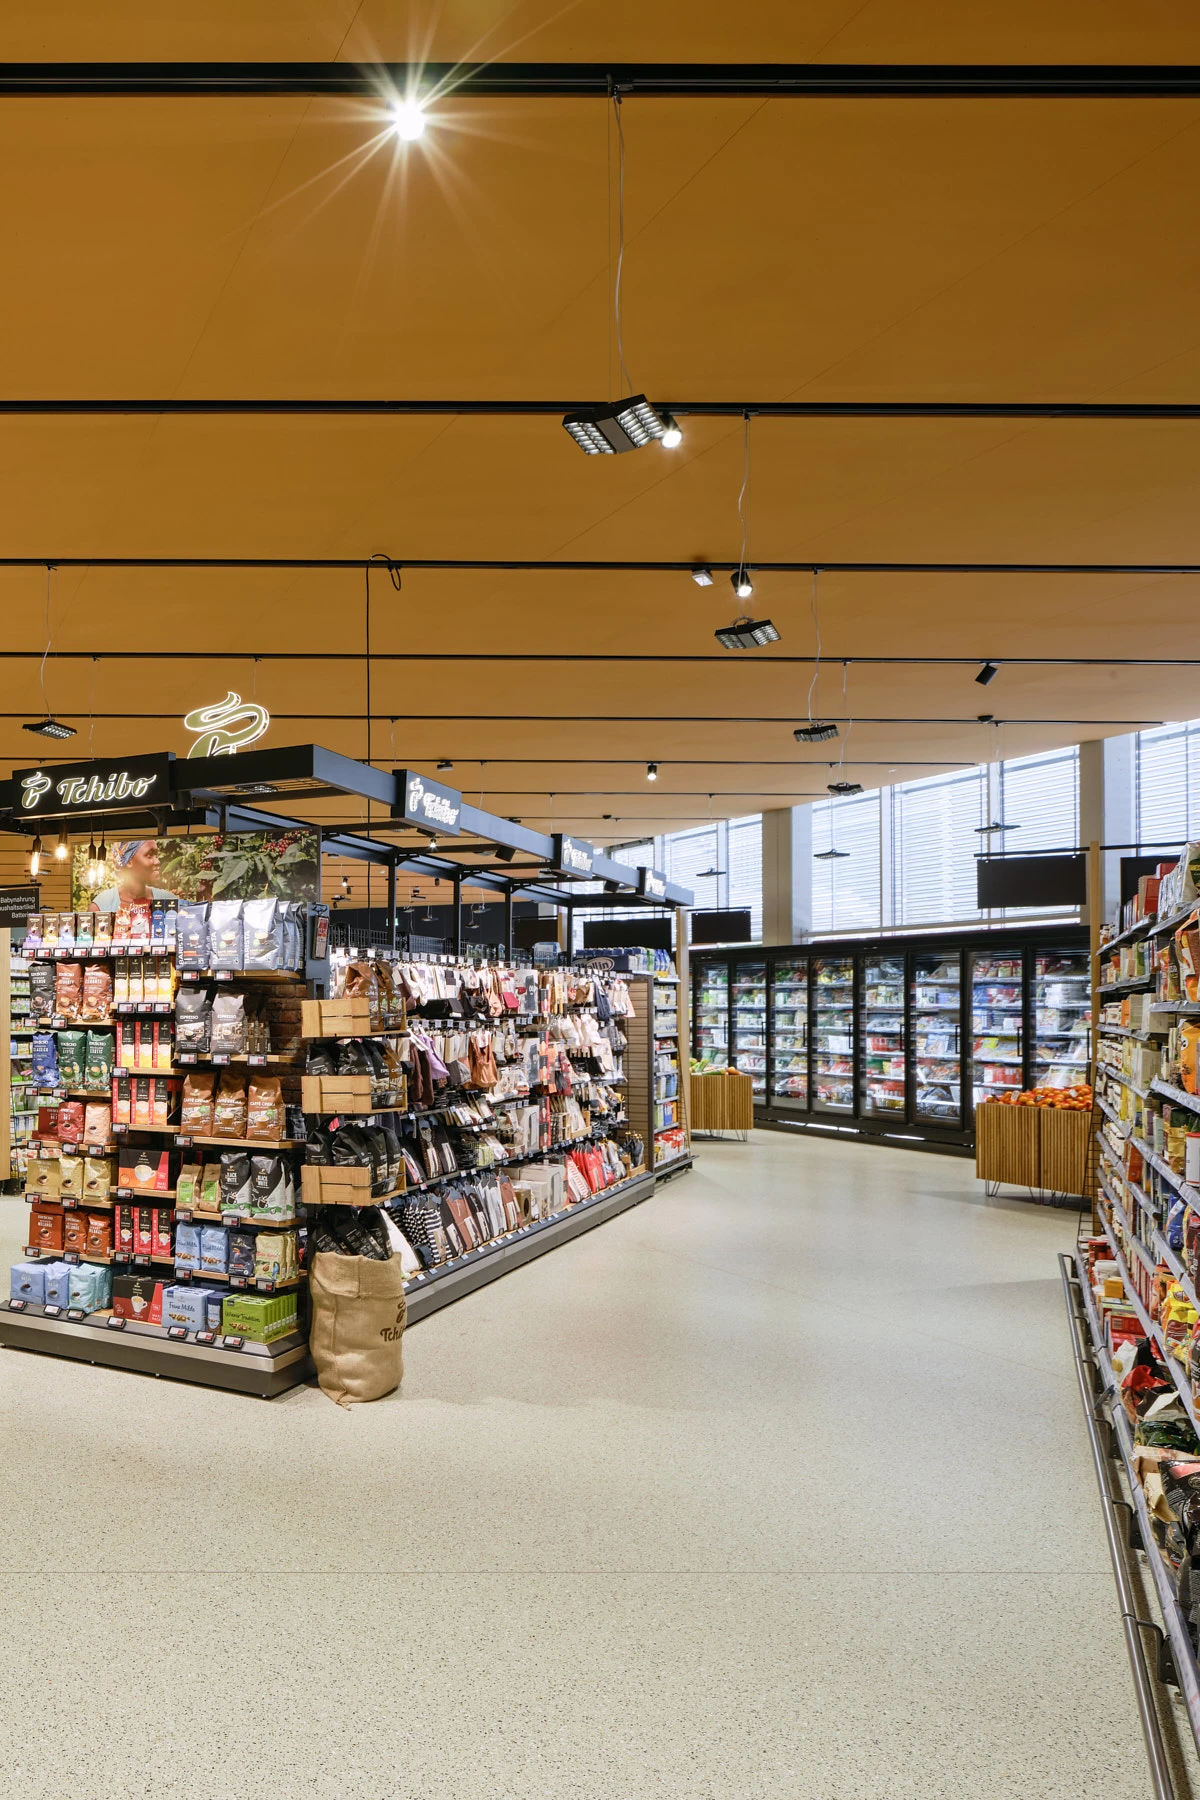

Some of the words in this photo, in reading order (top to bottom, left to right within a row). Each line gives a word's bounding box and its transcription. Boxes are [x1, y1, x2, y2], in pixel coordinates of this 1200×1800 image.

[56, 772, 157, 804] Tchibo
[0, 896, 35, 904] Babynahrung
[168, 1301, 181, 1309] Feine
[181, 1304, 196, 1312] Milde
[240, 1313, 261, 1322] Tradition
